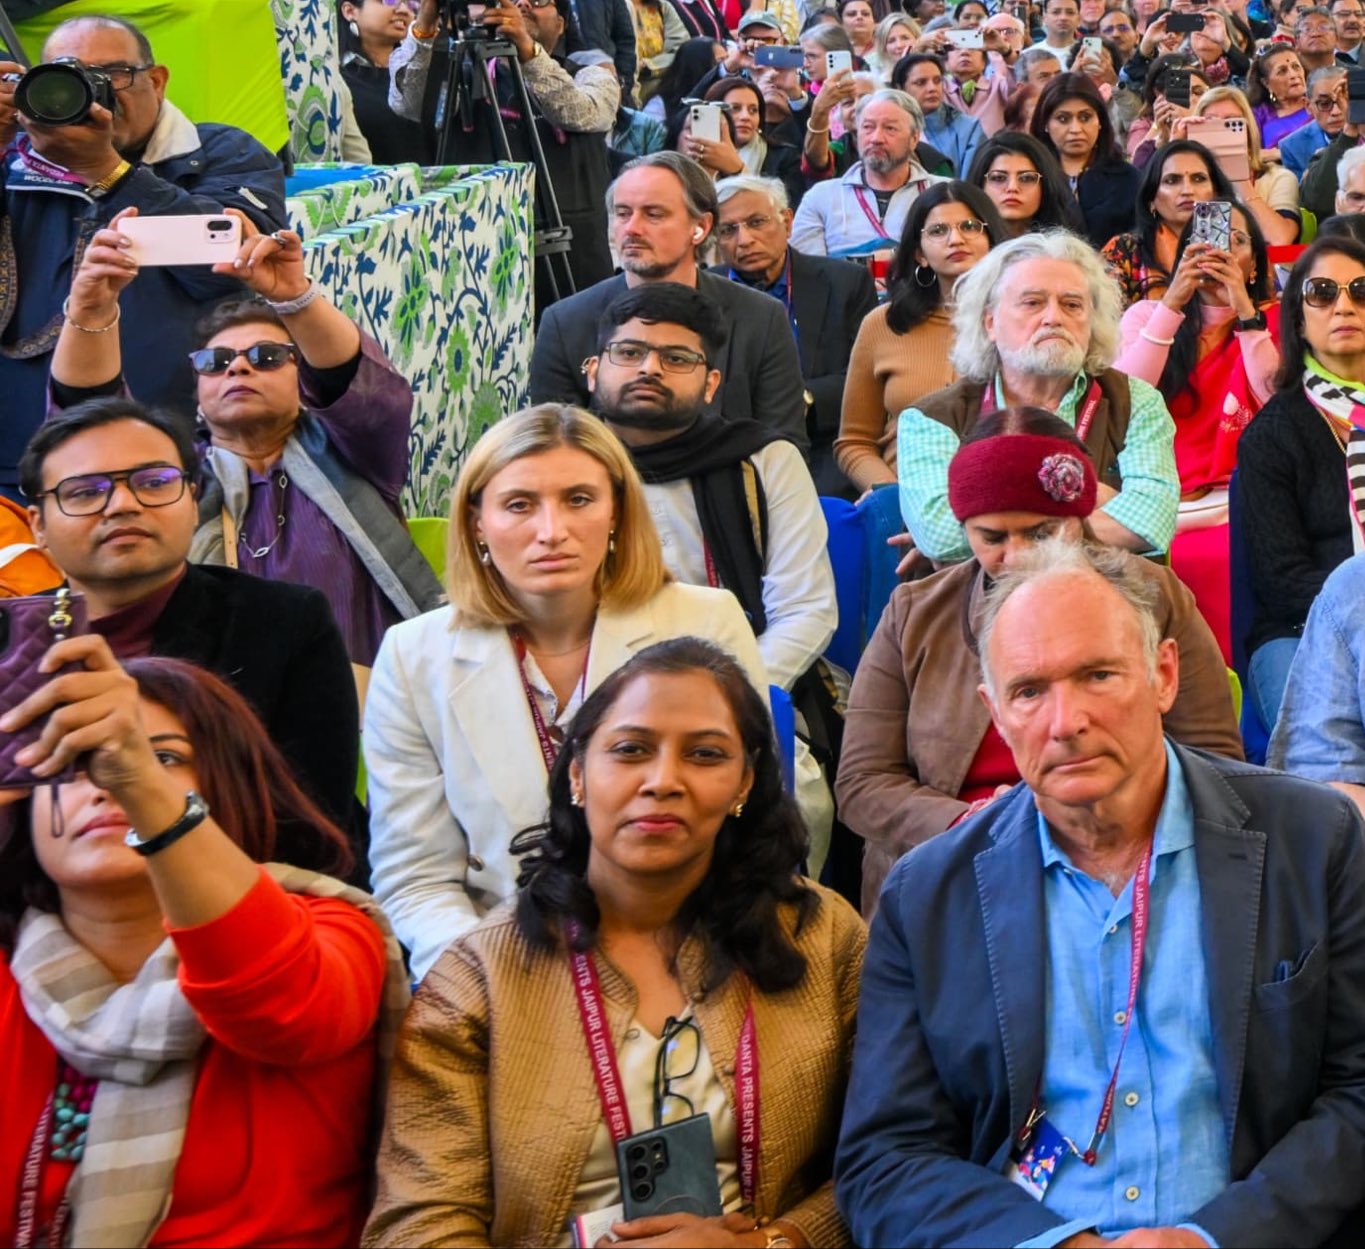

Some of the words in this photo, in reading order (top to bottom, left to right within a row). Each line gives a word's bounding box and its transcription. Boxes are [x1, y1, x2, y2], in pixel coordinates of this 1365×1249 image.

[1134, 885, 1145, 928] JAIPUR
[576, 954, 592, 987] ENTS
[582, 988, 602, 1031] JAIPUR
[591, 1031, 619, 1105] LITERATURE
[742, 1034, 752, 1074] DANTA
[609, 1107, 627, 1141] FESTI
[742, 1076, 755, 1144] PRESENTS
[742, 1145, 752, 1186] JAIPUR
